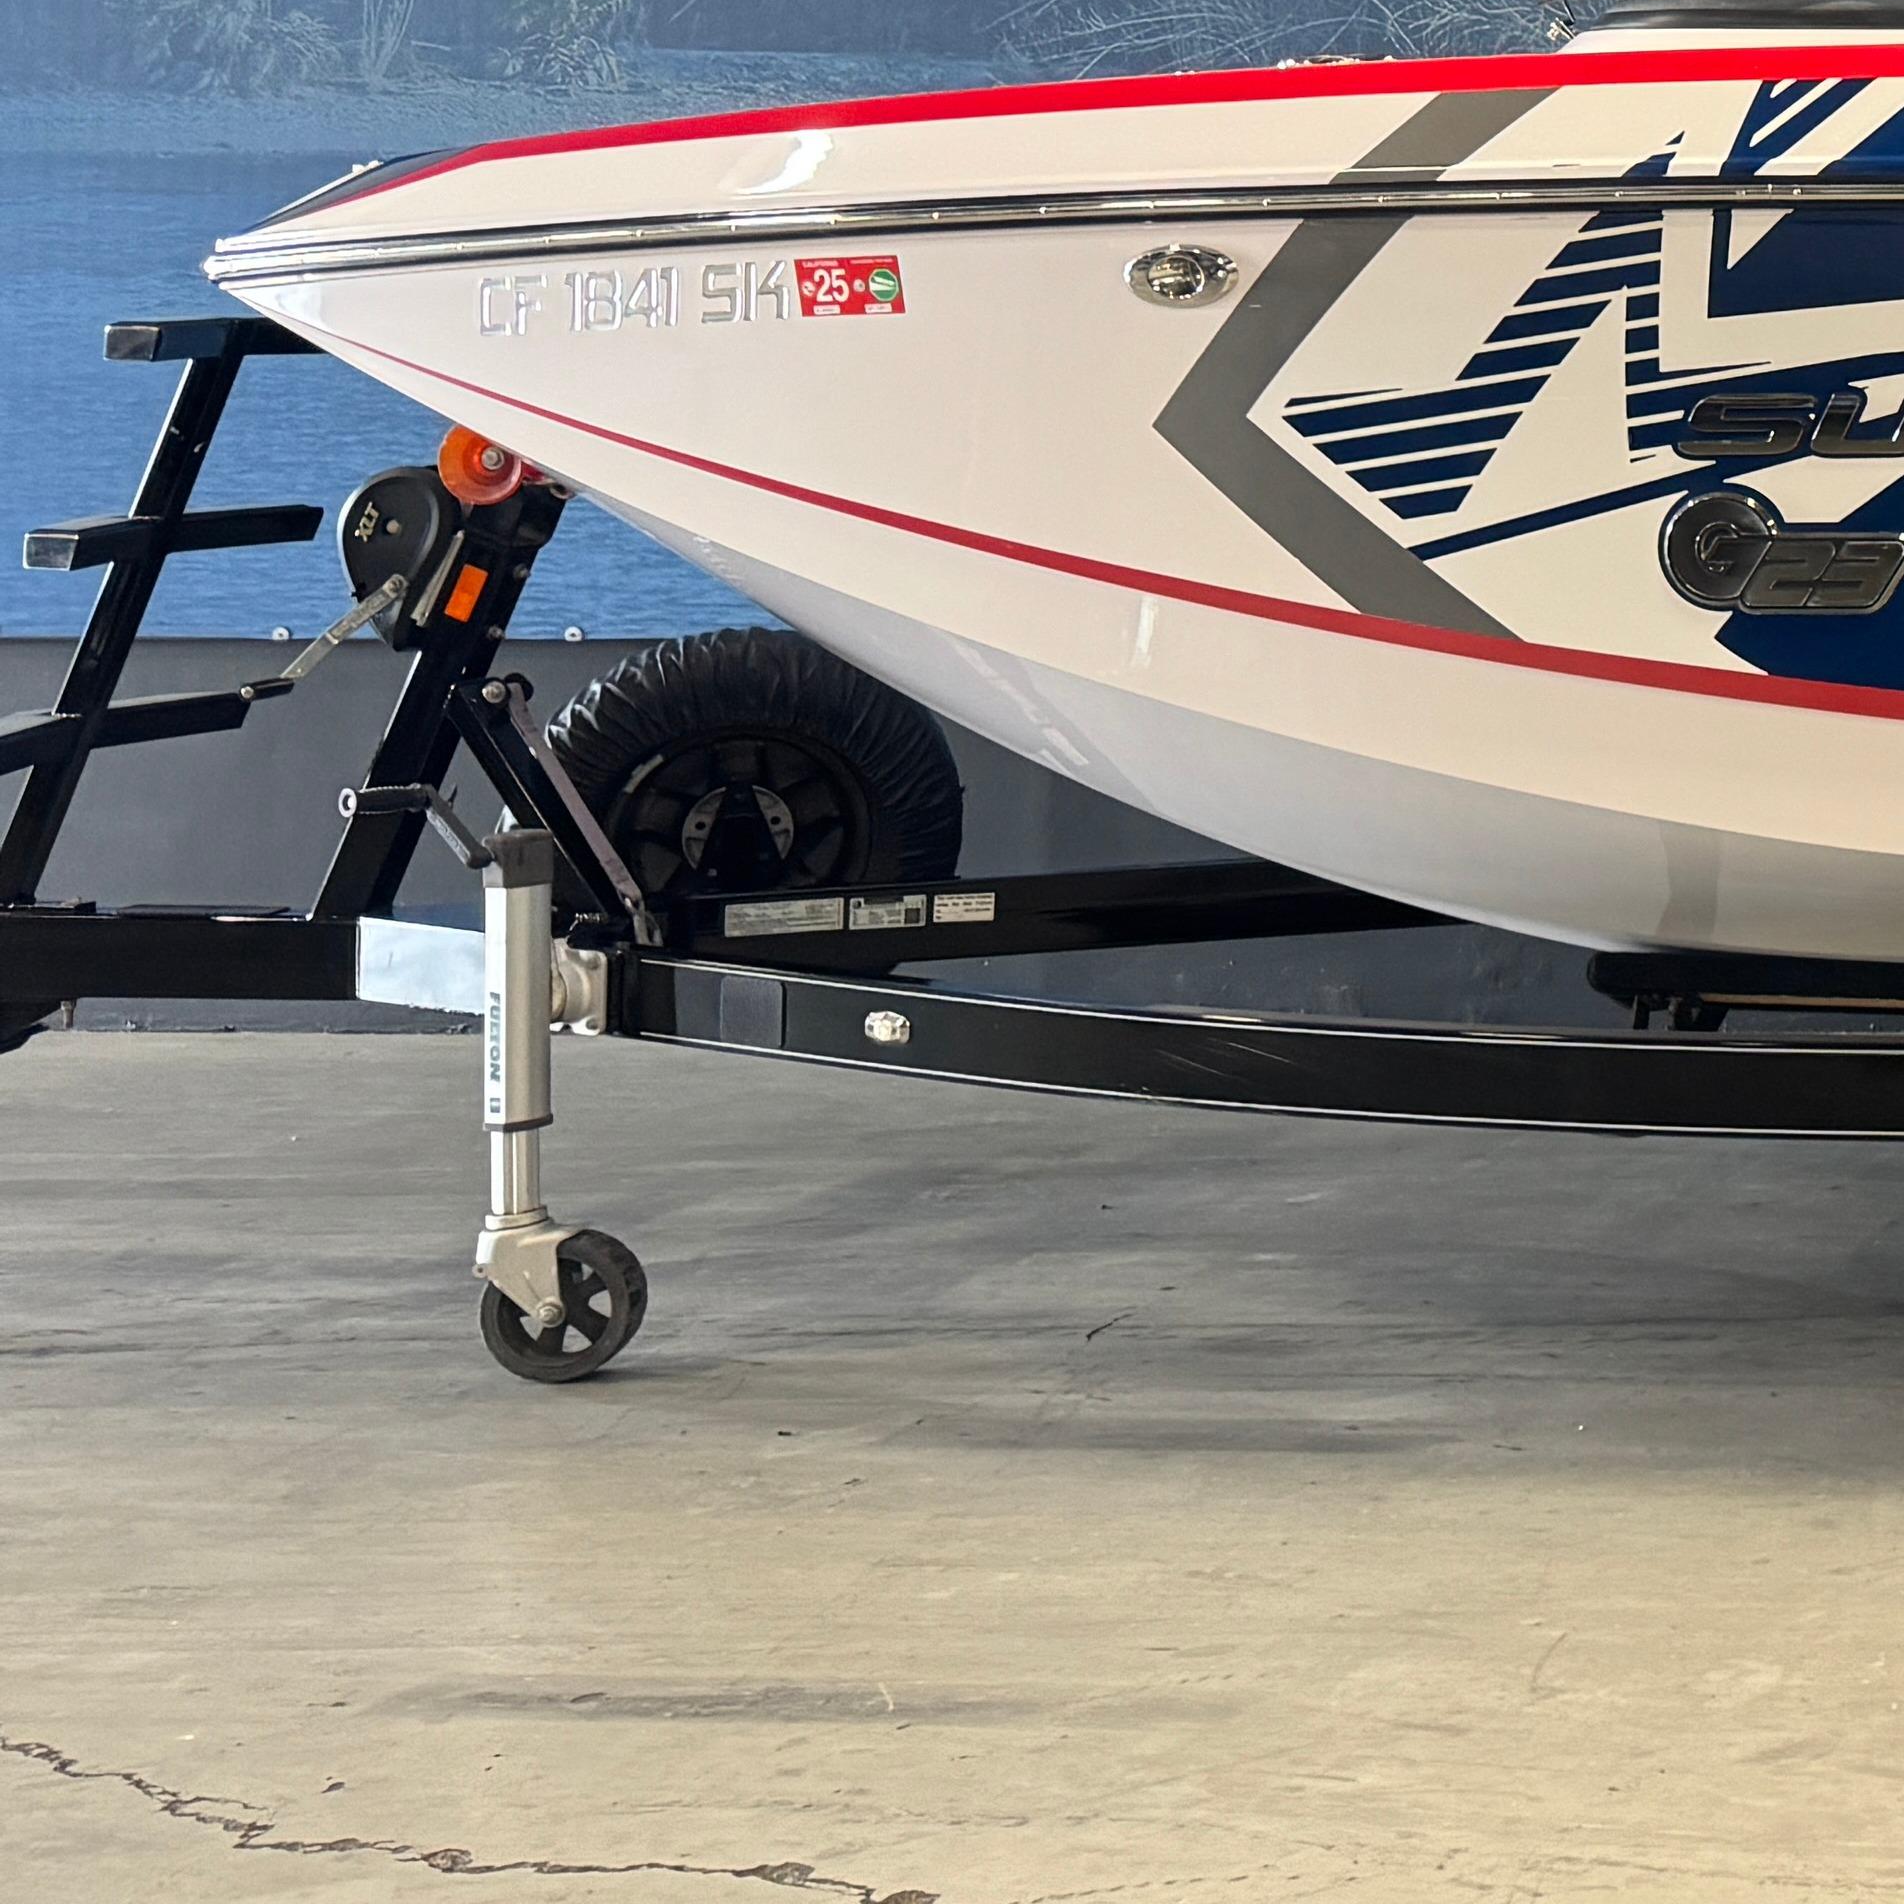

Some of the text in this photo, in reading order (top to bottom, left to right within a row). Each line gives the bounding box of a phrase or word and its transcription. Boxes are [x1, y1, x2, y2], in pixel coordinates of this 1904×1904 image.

[480, 260, 789, 336] CF 1841 SK
[813, 268, 850, 303] 25
[489, 991, 502, 1083] FULTON
